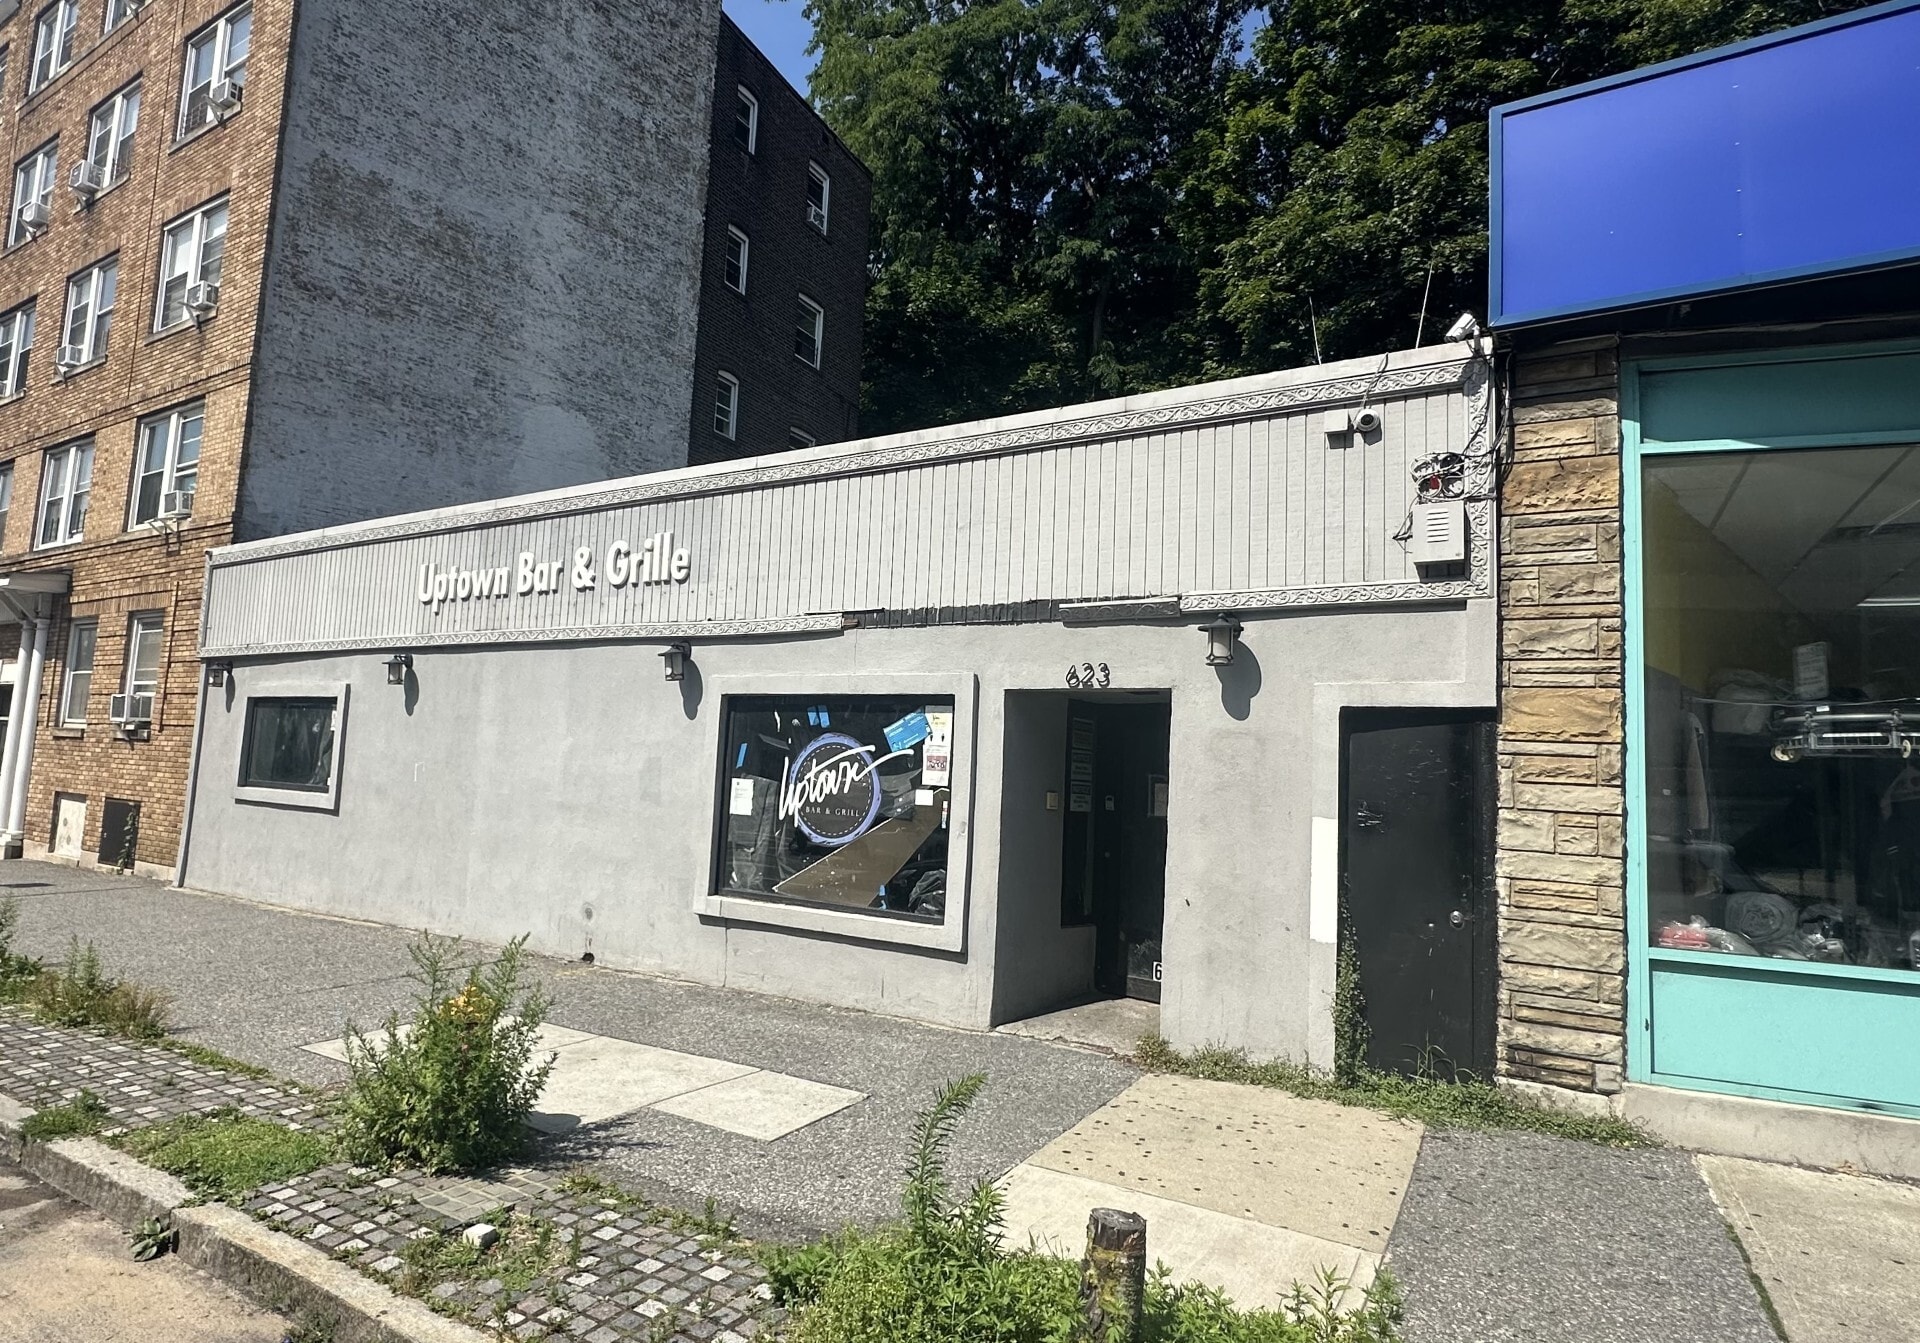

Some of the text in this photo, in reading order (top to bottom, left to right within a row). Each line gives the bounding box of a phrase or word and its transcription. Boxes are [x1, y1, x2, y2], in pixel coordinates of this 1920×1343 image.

[418, 532, 691, 615] Uptown Bar & Grille
[1065, 662, 1111, 689] 623
[805, 806, 821, 815] BAR
[835, 807, 861, 817] GRILL
